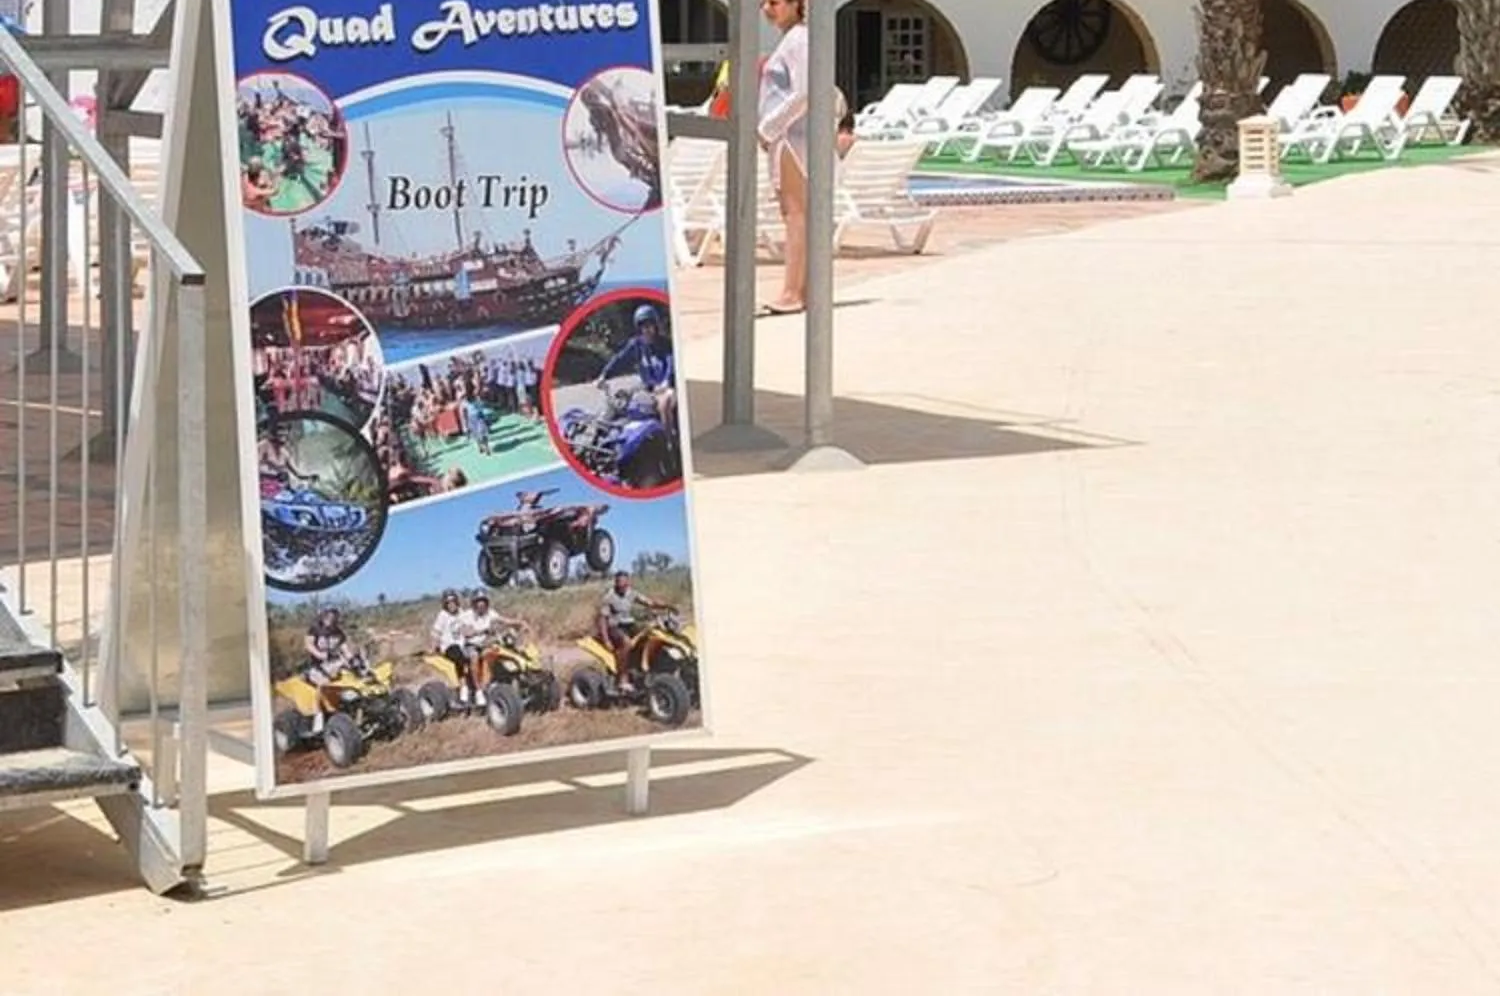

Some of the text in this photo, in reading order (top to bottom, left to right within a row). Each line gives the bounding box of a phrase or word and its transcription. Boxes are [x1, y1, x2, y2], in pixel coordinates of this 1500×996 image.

[263, 3, 396, 61] Quad
[387, 175, 549, 219] Boot Trip
